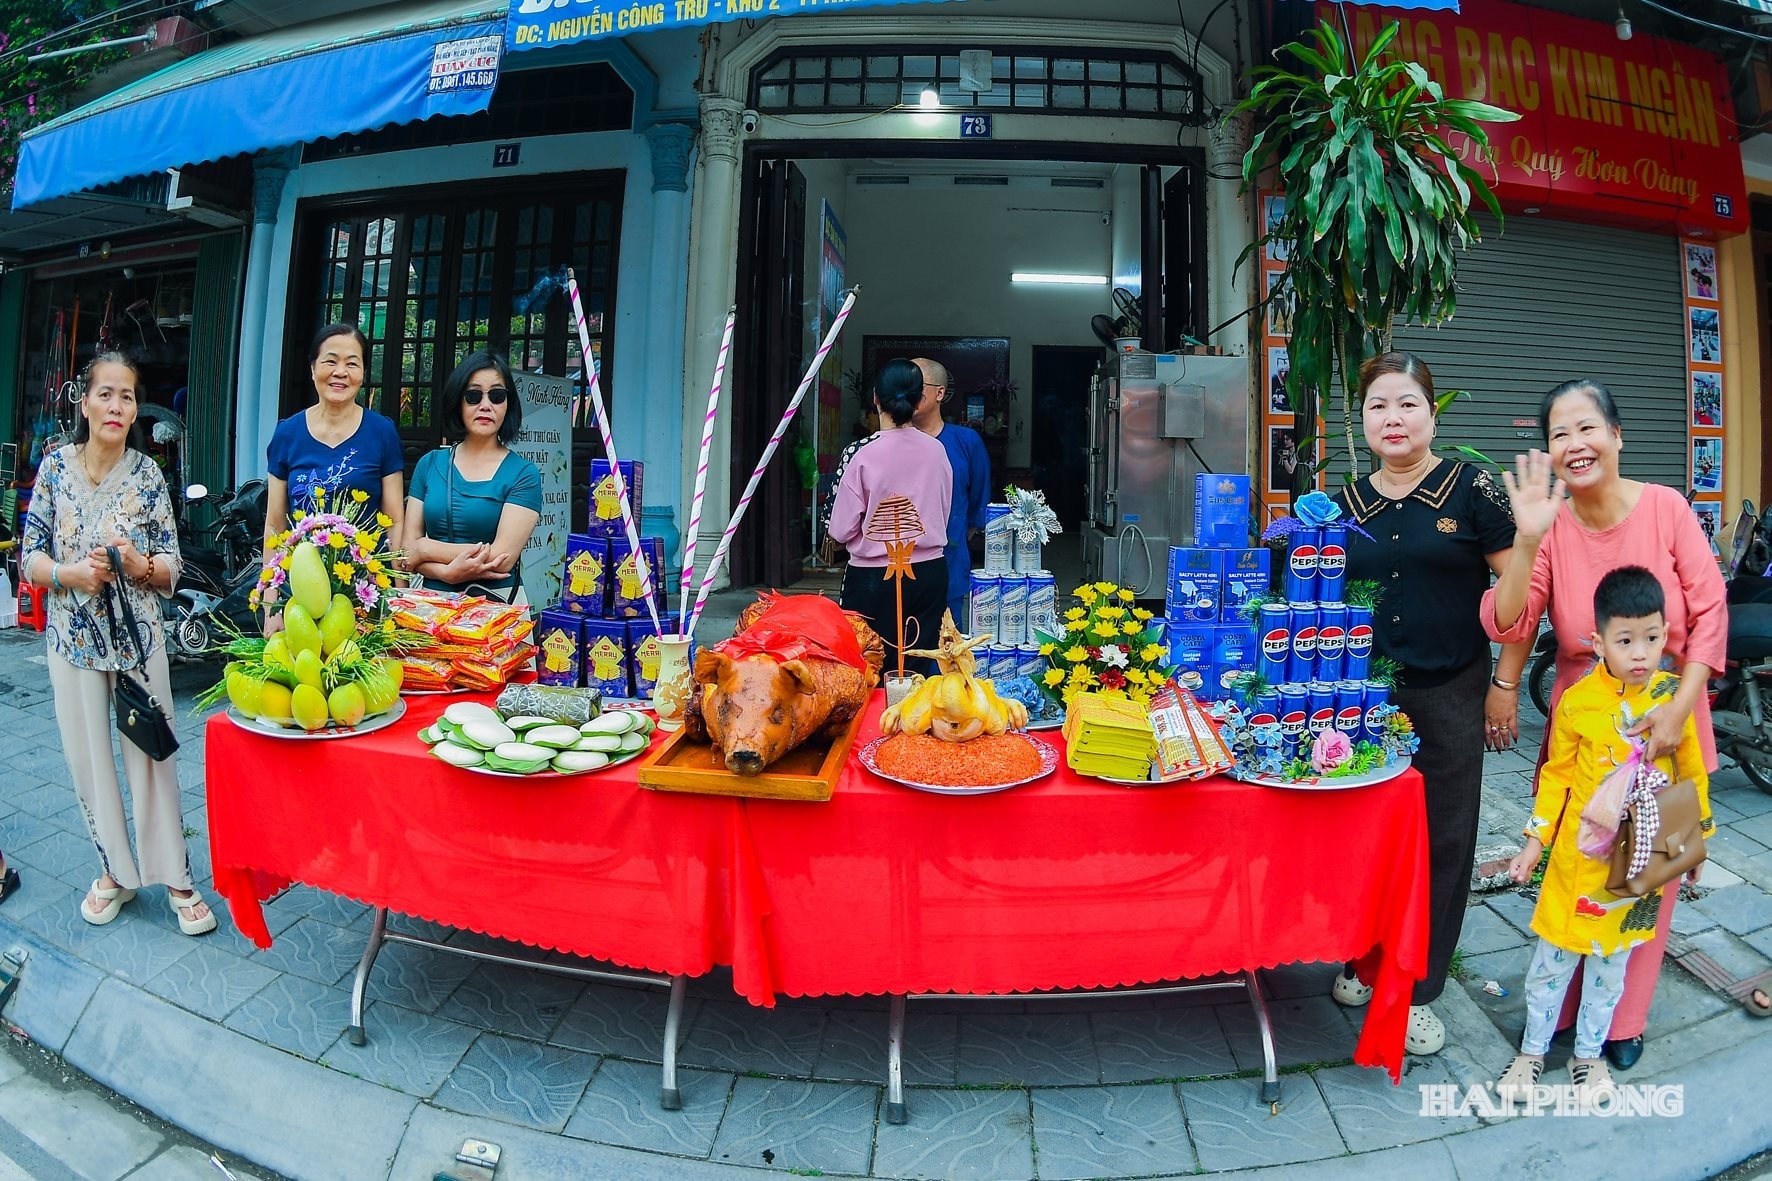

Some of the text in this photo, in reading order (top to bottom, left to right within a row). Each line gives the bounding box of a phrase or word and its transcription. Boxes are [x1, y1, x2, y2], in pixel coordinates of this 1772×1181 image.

[516, 25, 543, 44] ĐC:
[547, 6, 613, 41] NGUYỄN
[617, 3, 664, 30] CÔNG
[1546, 43, 1624, 127] KIM
[1624, 60, 1720, 148] NGÂN
[964, 117, 986, 135] 73
[498, 148, 512, 163] 71
[1510, 135, 1566, 181] Quý
[1571, 146, 1631, 184] Hơn
[1634, 158, 1700, 204] Vàng
[1715, 196, 1729, 214] 75
[80, 245, 89, 258] 69
[1291, 557, 1317, 566] PEPS
[573, 564, 596, 575] MERRY
[547, 642, 570, 653] MERRY
[1264, 640, 1289, 650] PEPS
[1347, 637, 1372, 646] PEPS
[594, 650, 618, 660] MERRY
[1337, 717, 1360, 727] PEPS
